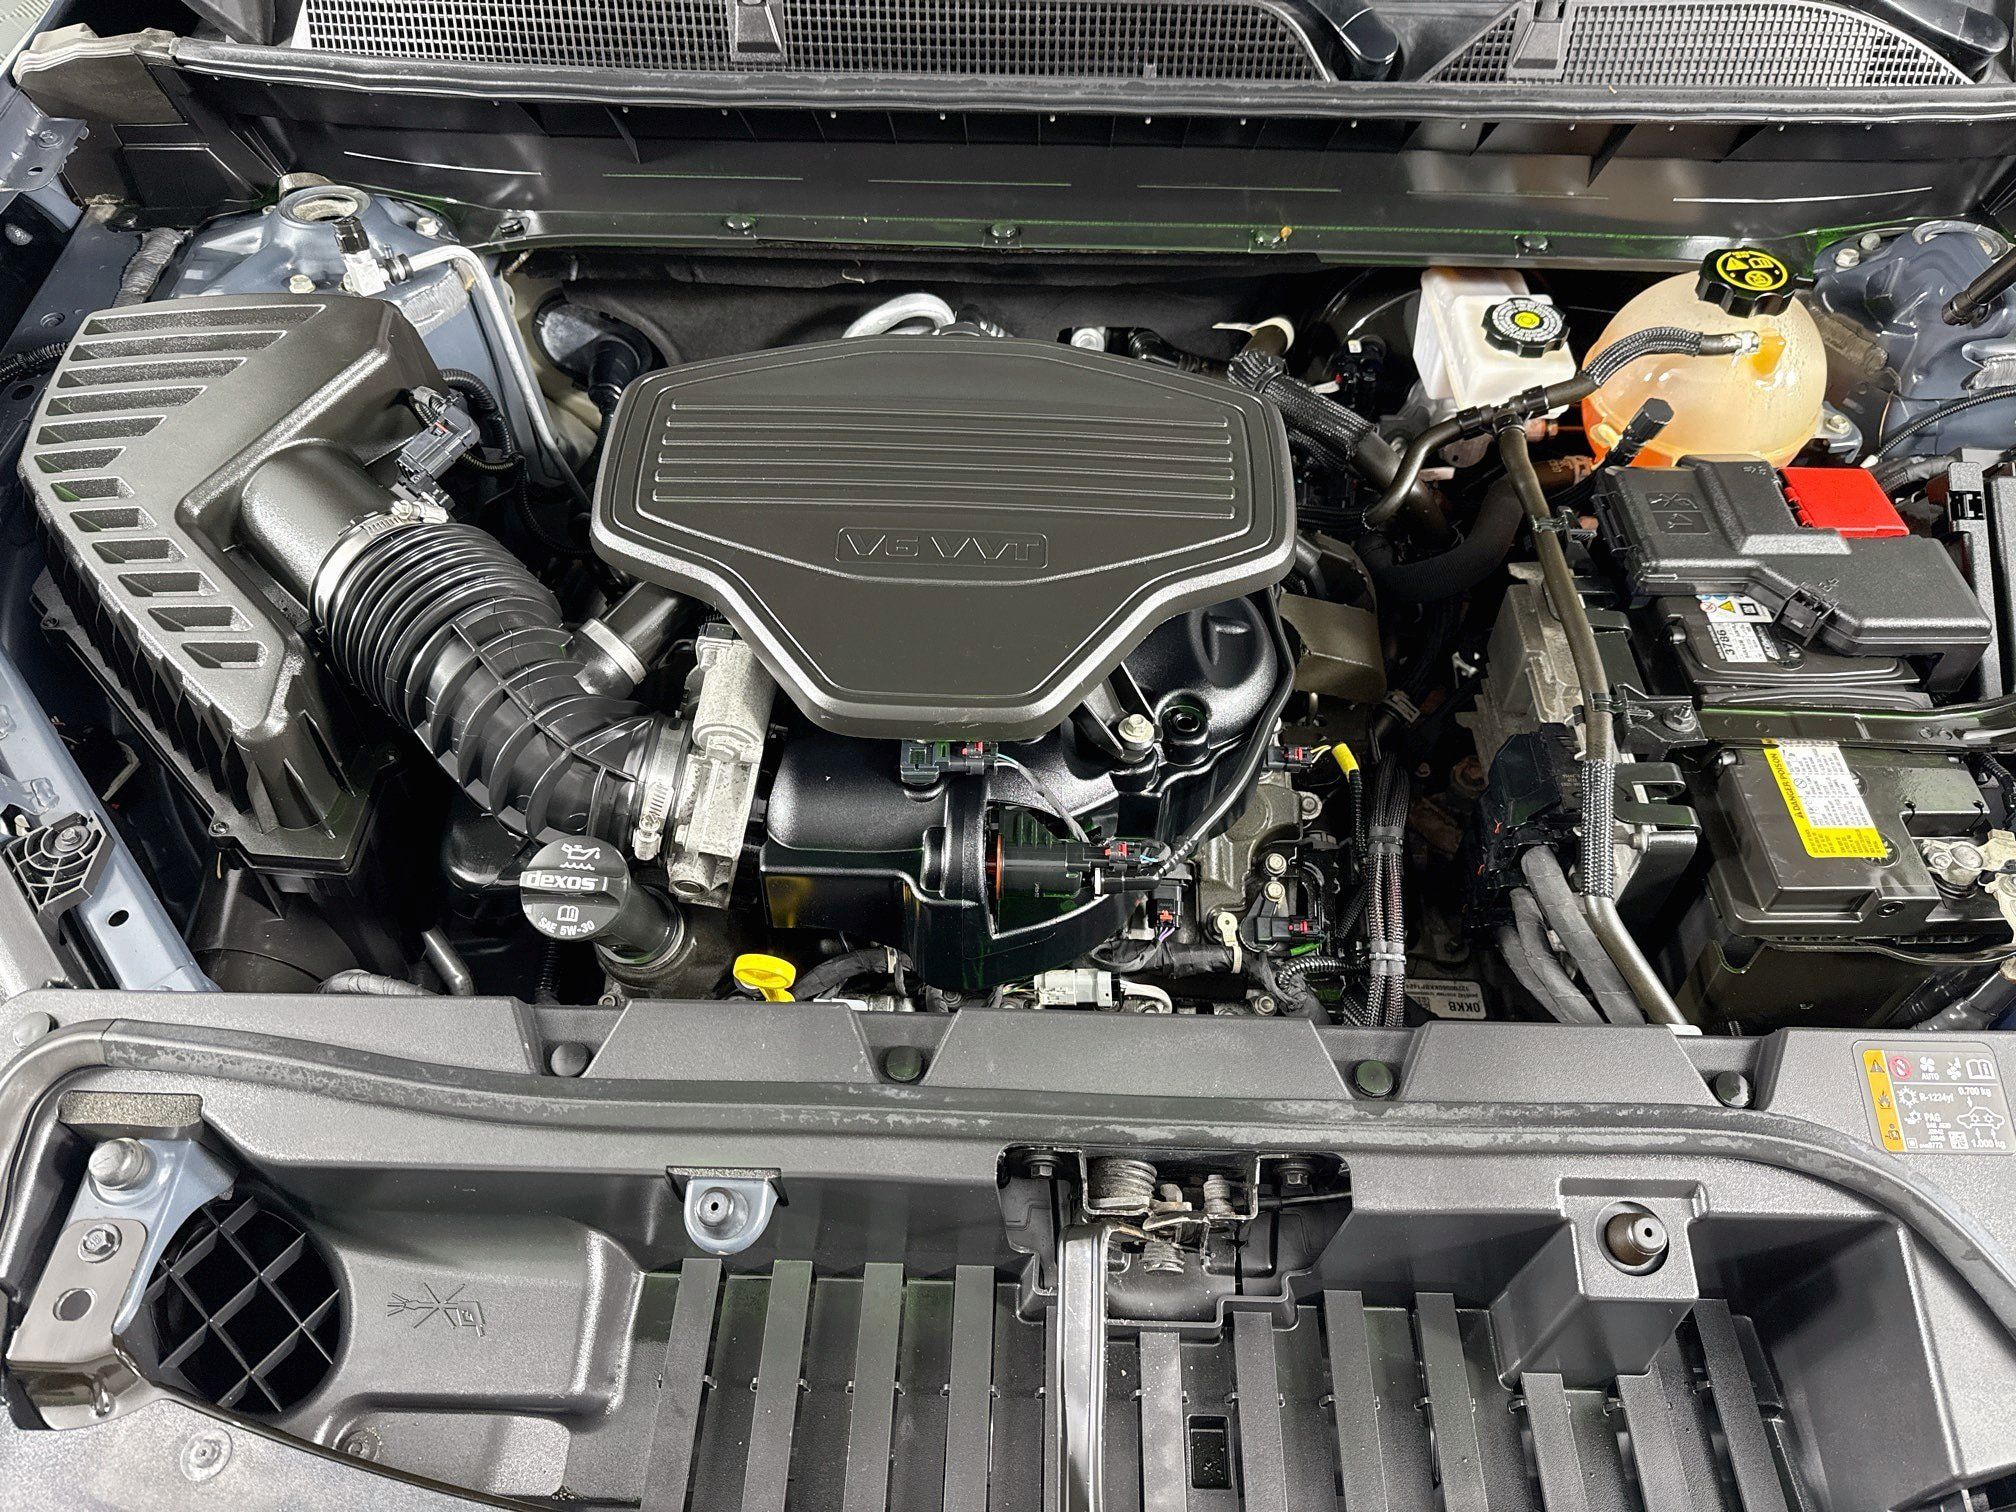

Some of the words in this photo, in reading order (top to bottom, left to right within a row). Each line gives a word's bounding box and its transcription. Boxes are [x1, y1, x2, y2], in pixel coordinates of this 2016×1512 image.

[846, 534, 919, 557] V6
[931, 536, 1040, 561] VVT
[1769, 753, 1789, 781] POISON
[1783, 780, 1801, 814] DANGER
[526, 870, 599, 891] dexos
[538, 917, 558, 934] SAE
[559, 920, 596, 936] 5W-30
[1921, 1073, 1940, 1081] AUTO
[1958, 1087, 1980, 1096] 0.700
[1980, 1087, 1992, 1097] kg
[1924, 1113, 1942, 1123] PAG
[1971, 1139, 1994, 1148] 1.000
[1994, 1139, 2007, 1150] kg
